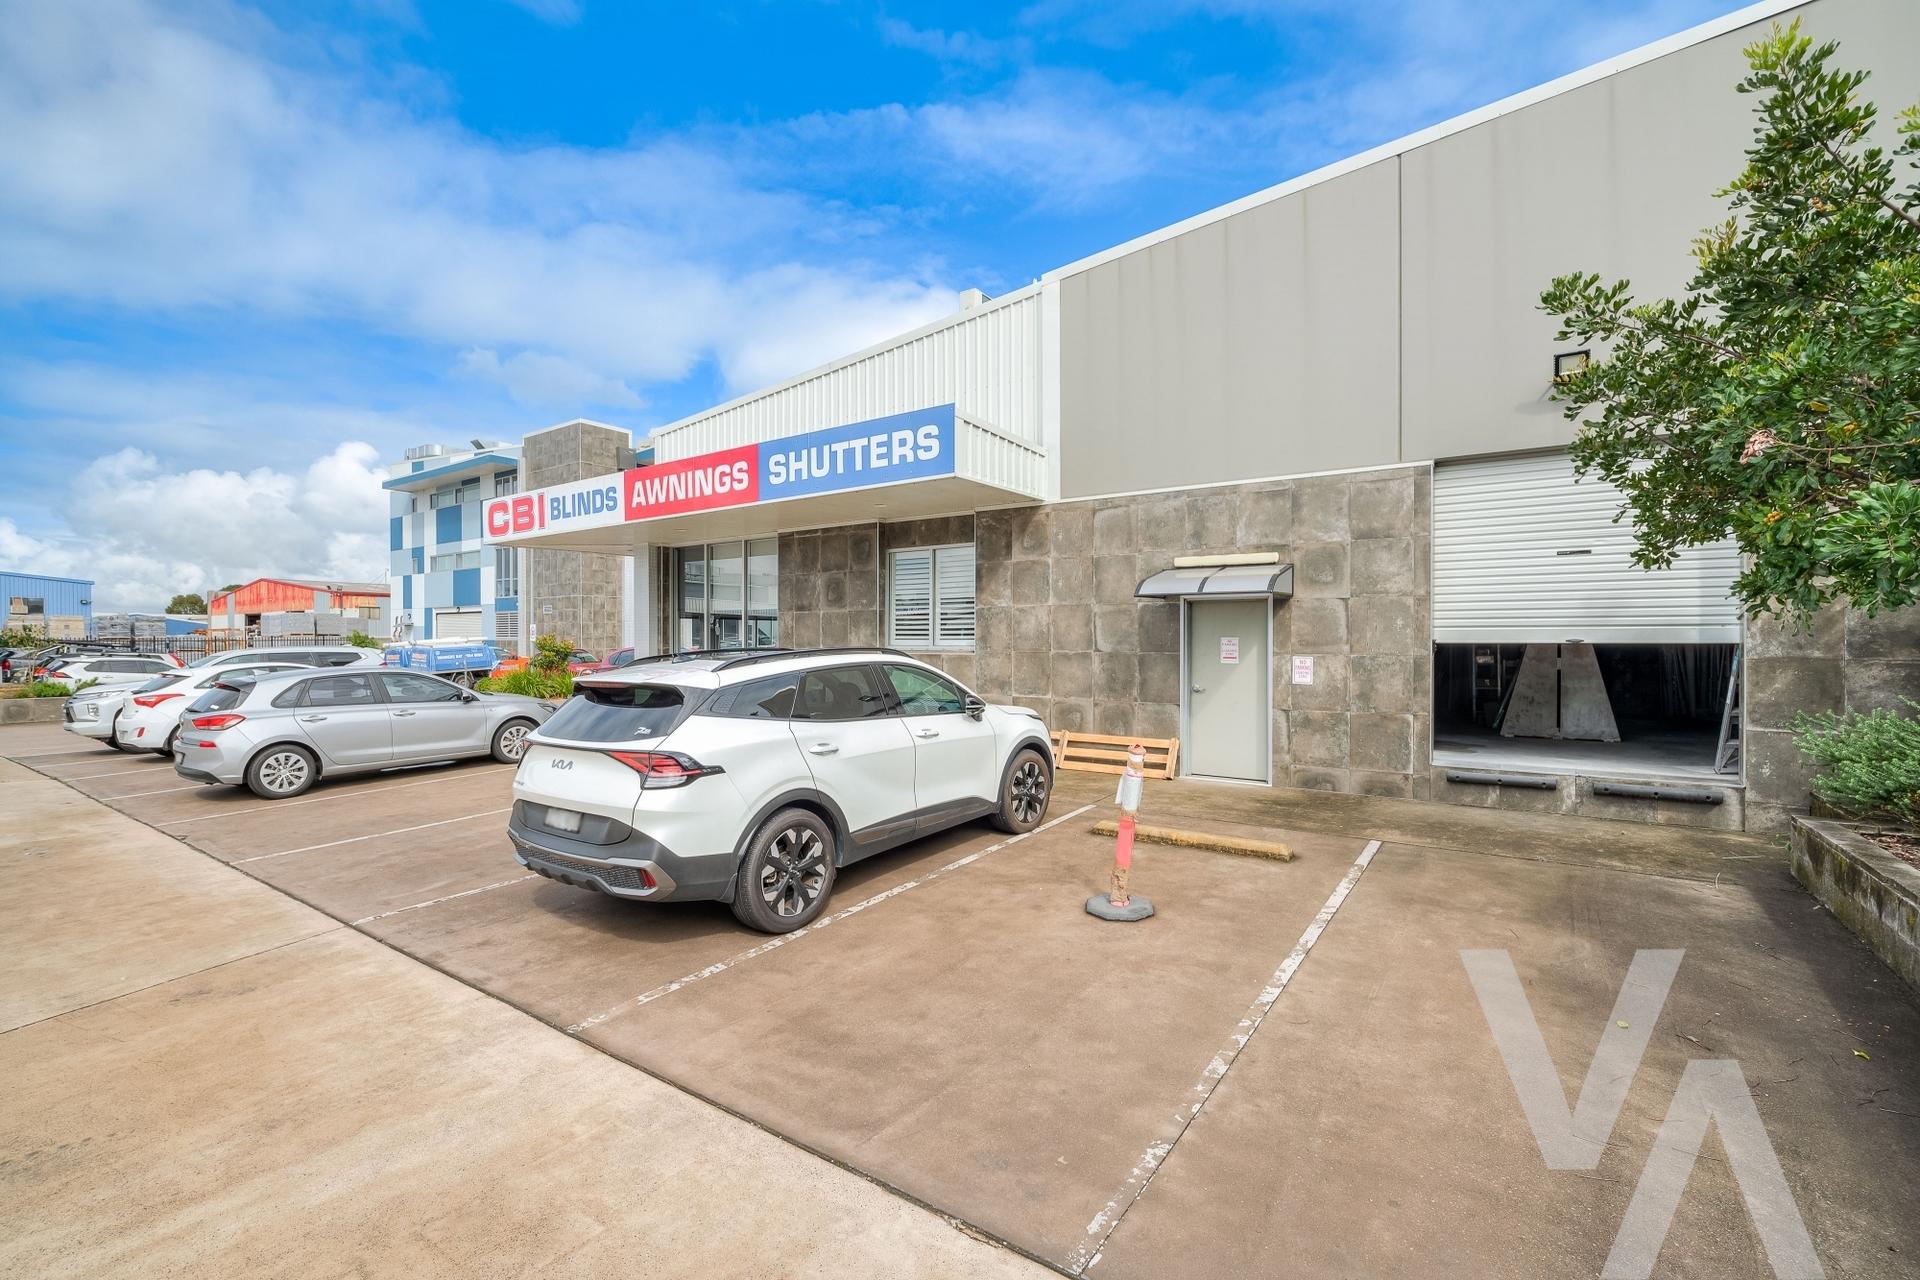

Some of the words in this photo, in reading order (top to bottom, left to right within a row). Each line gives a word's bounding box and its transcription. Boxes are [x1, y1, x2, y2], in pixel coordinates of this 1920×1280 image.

[550, 486, 618, 521] BLINDS
[631, 460, 749, 508] AWNINGS
[768, 424, 940, 486] SHUTTERS
